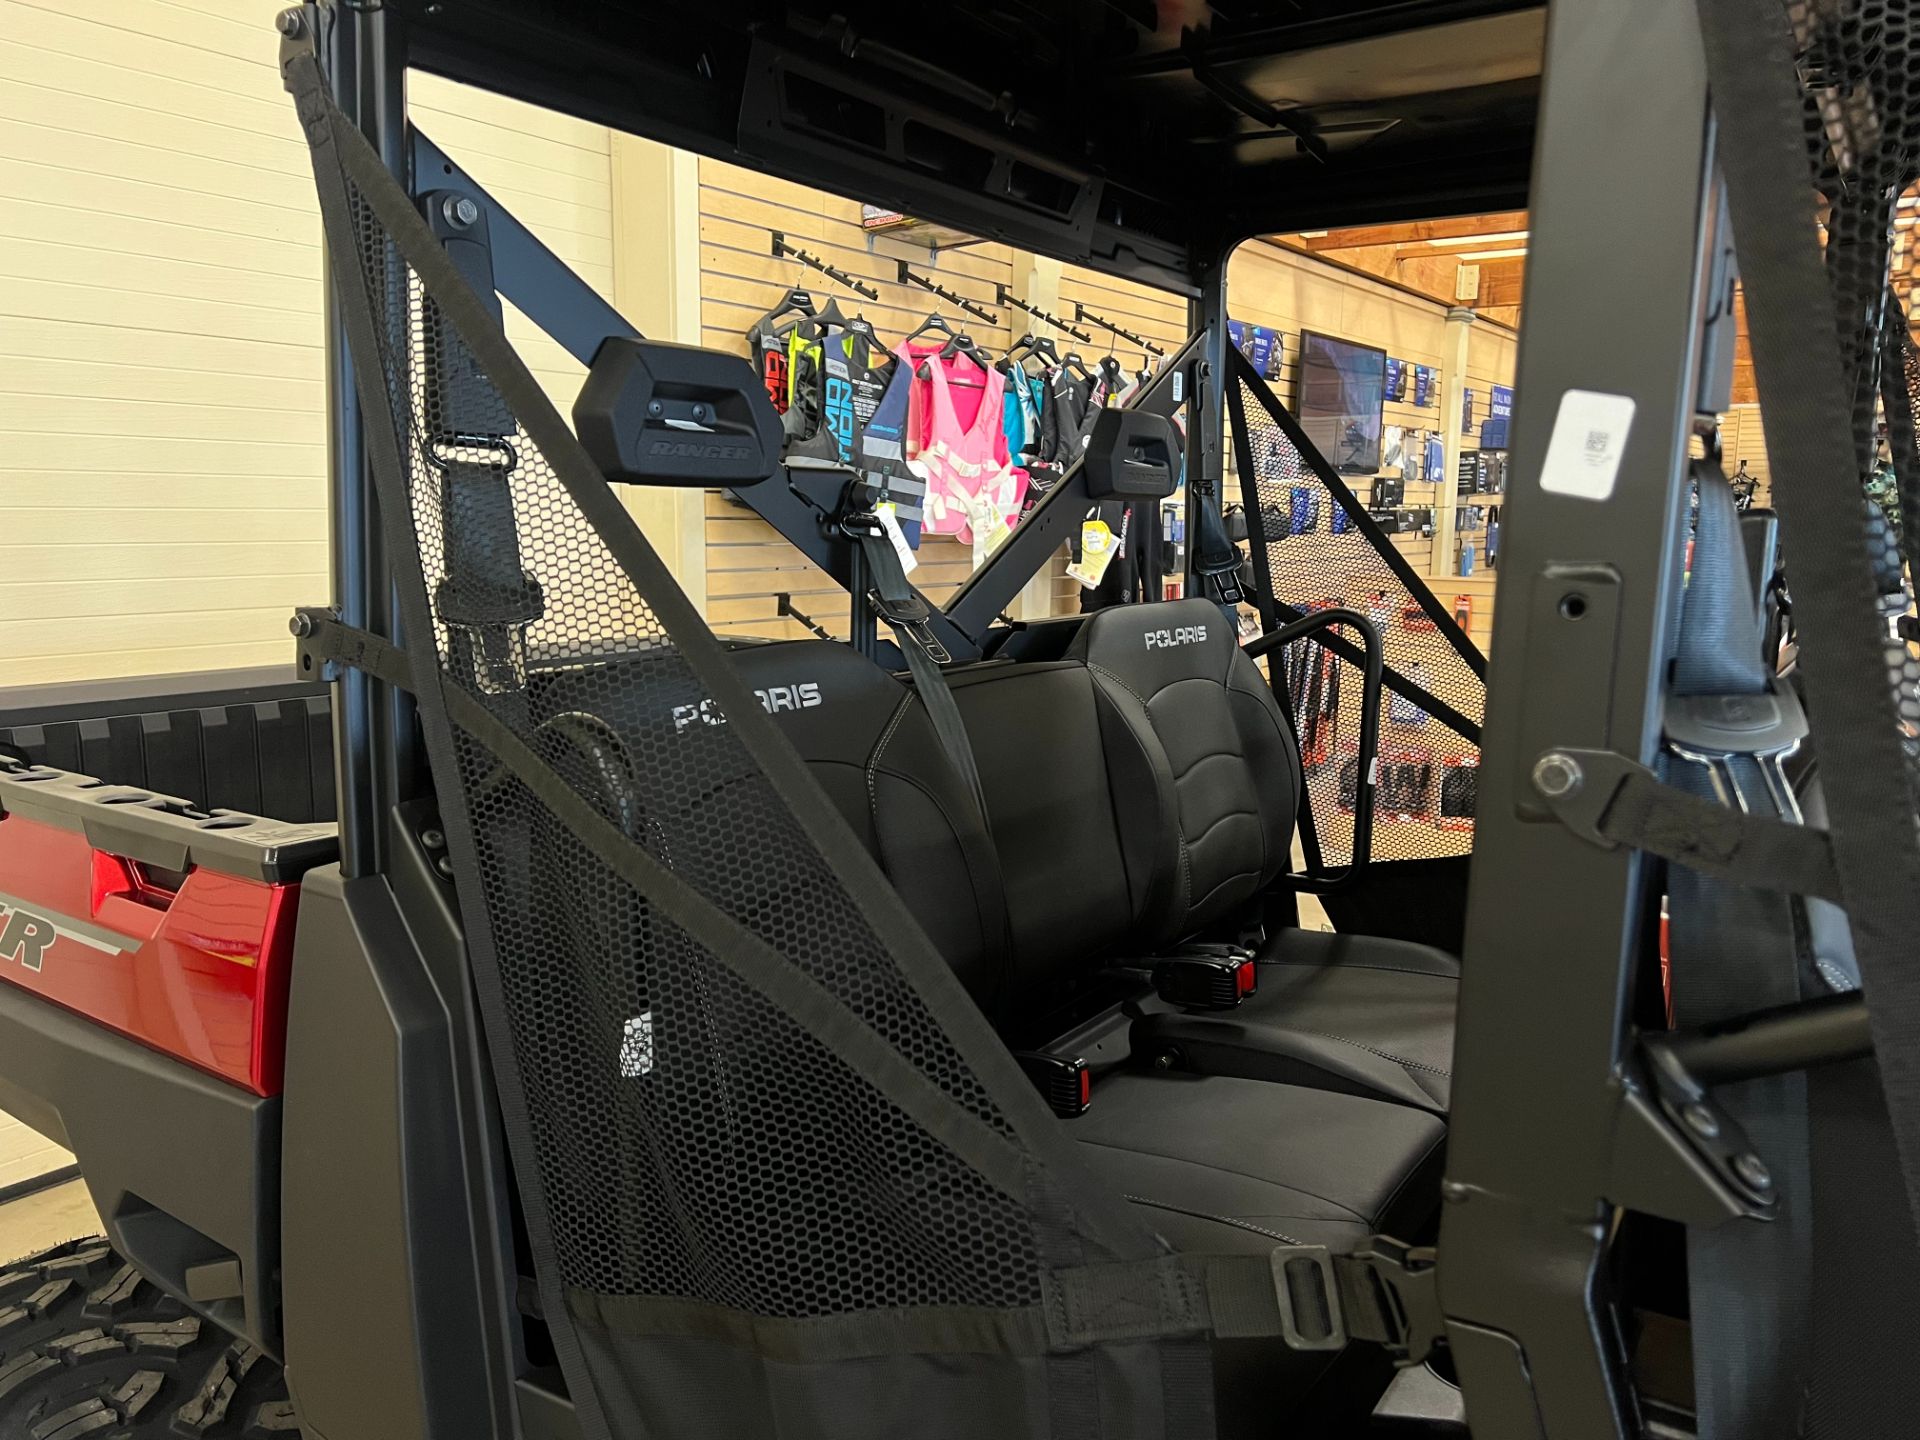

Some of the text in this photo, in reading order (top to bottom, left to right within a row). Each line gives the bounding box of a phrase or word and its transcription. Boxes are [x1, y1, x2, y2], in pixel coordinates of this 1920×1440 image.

[648, 440, 752, 460] RANGER
[1143, 625, 1208, 651] POLARIS
[671, 682, 822, 734] POARIS
